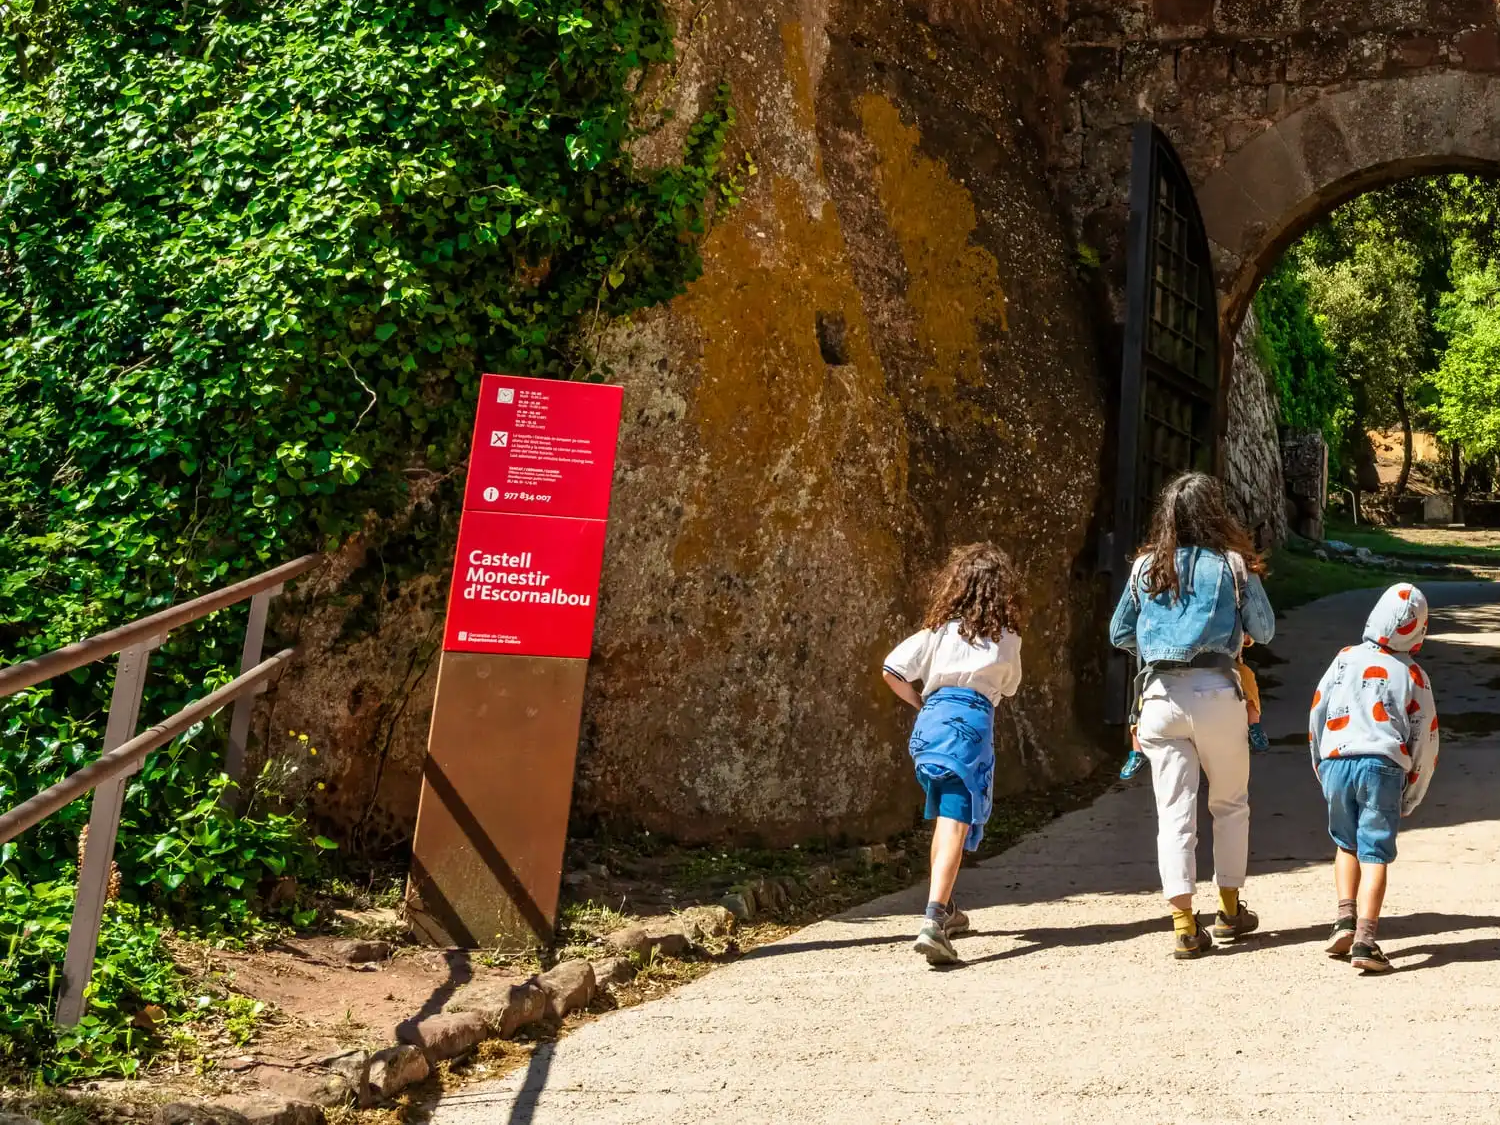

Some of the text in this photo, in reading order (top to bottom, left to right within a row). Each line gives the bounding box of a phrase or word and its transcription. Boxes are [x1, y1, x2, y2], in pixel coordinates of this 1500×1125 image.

[504, 491, 552, 503] 977 834 007
[469, 550, 532, 568] Castell
[465, 567, 550, 586] Monestir
[463, 584, 591, 606] d'Escornalbou
